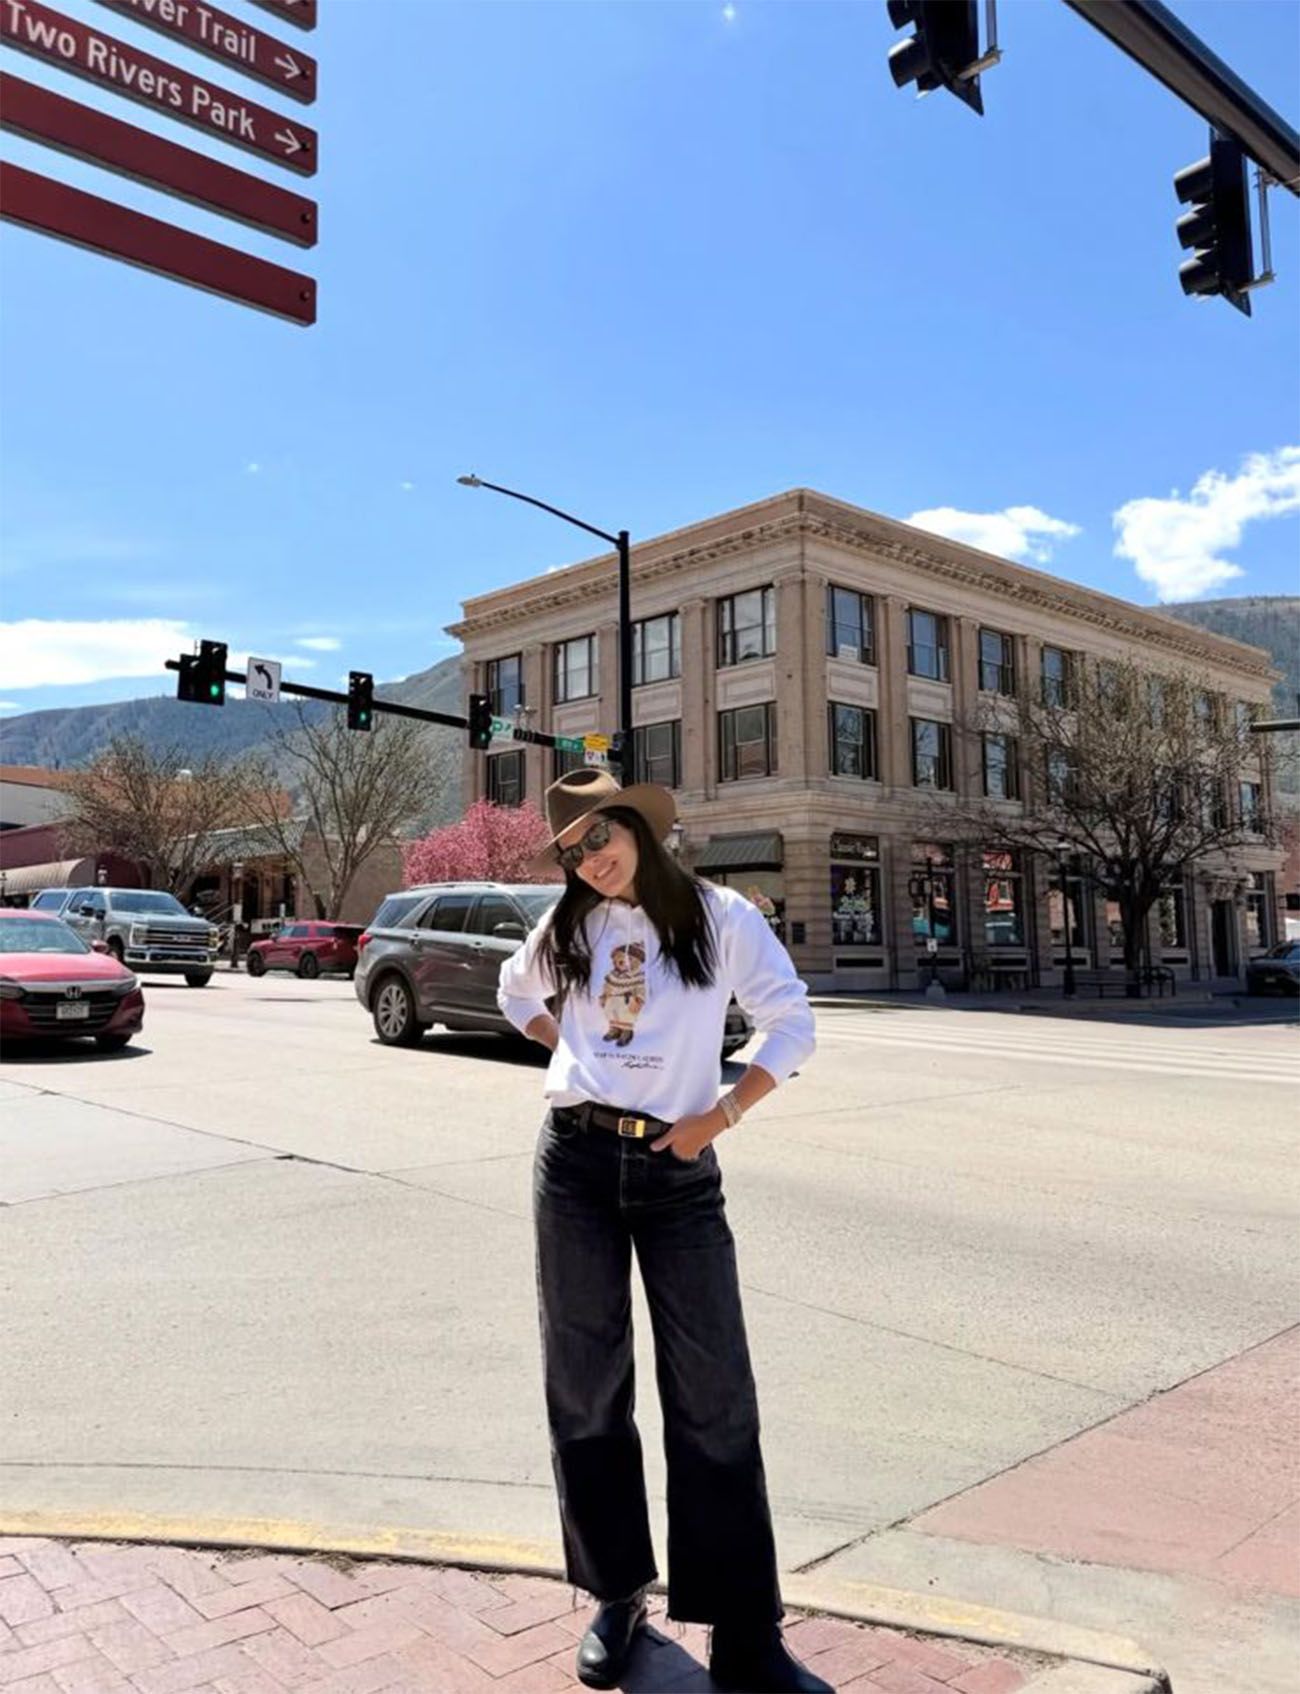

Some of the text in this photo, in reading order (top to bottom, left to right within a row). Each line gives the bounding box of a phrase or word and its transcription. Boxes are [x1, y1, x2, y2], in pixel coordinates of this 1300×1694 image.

[7, 0, 256, 141] Two Rivers Park
[131, 0, 256, 63] ver Trail
